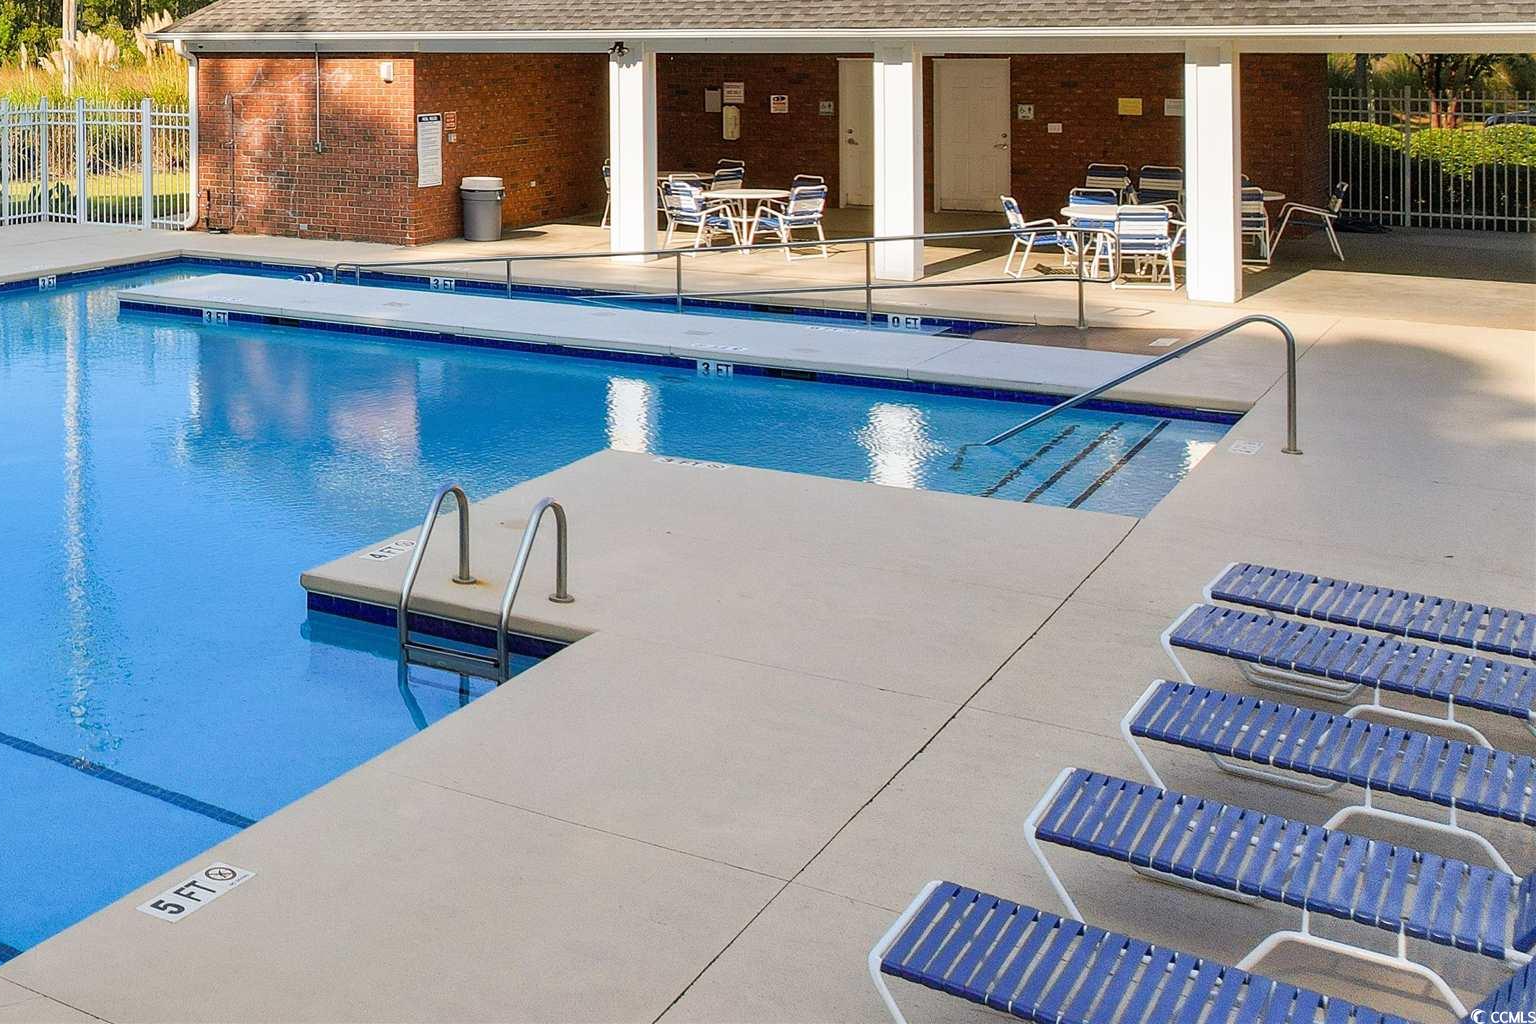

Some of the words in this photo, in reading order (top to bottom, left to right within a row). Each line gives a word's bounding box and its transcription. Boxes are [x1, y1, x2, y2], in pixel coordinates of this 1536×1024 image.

[433, 278, 440, 289] 3
[444, 279, 454, 290] FT
[892, 316, 900, 328] 0
[905, 317, 919, 329] FT
[716, 363, 731, 375] FT
[150, 899, 185, 915] 5
[173, 880, 217, 902] FT
